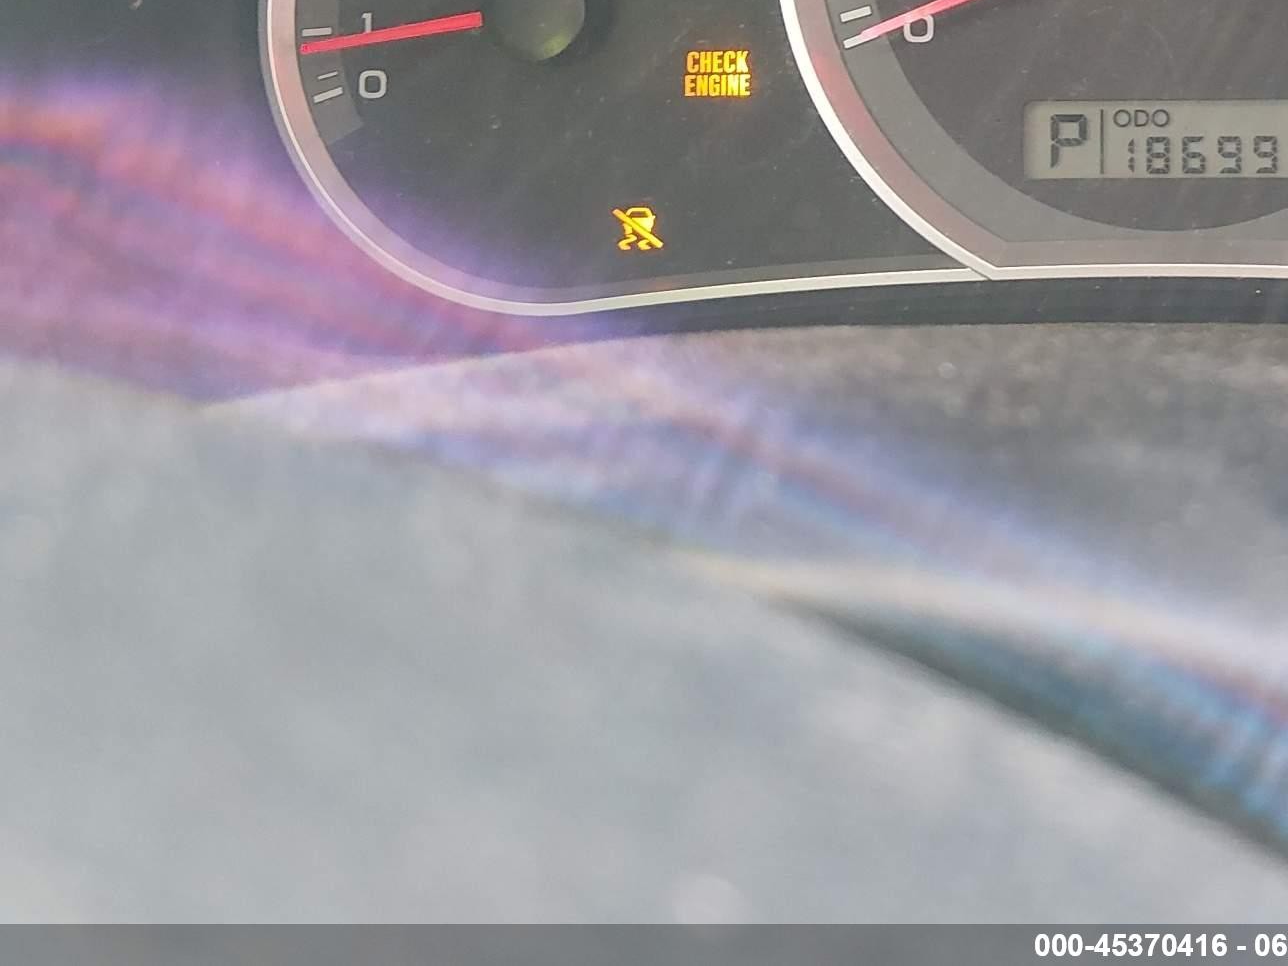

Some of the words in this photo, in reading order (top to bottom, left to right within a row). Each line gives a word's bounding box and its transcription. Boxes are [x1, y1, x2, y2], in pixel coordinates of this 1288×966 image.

[903, 14, 934, 42] 0
[687, 51, 748, 73] CHECK
[359, 70, 387, 98] 0
[685, 74, 750, 96] ENGINE
[1113, 109, 1170, 128] ODO
[1051, 114, 1087, 168] P
